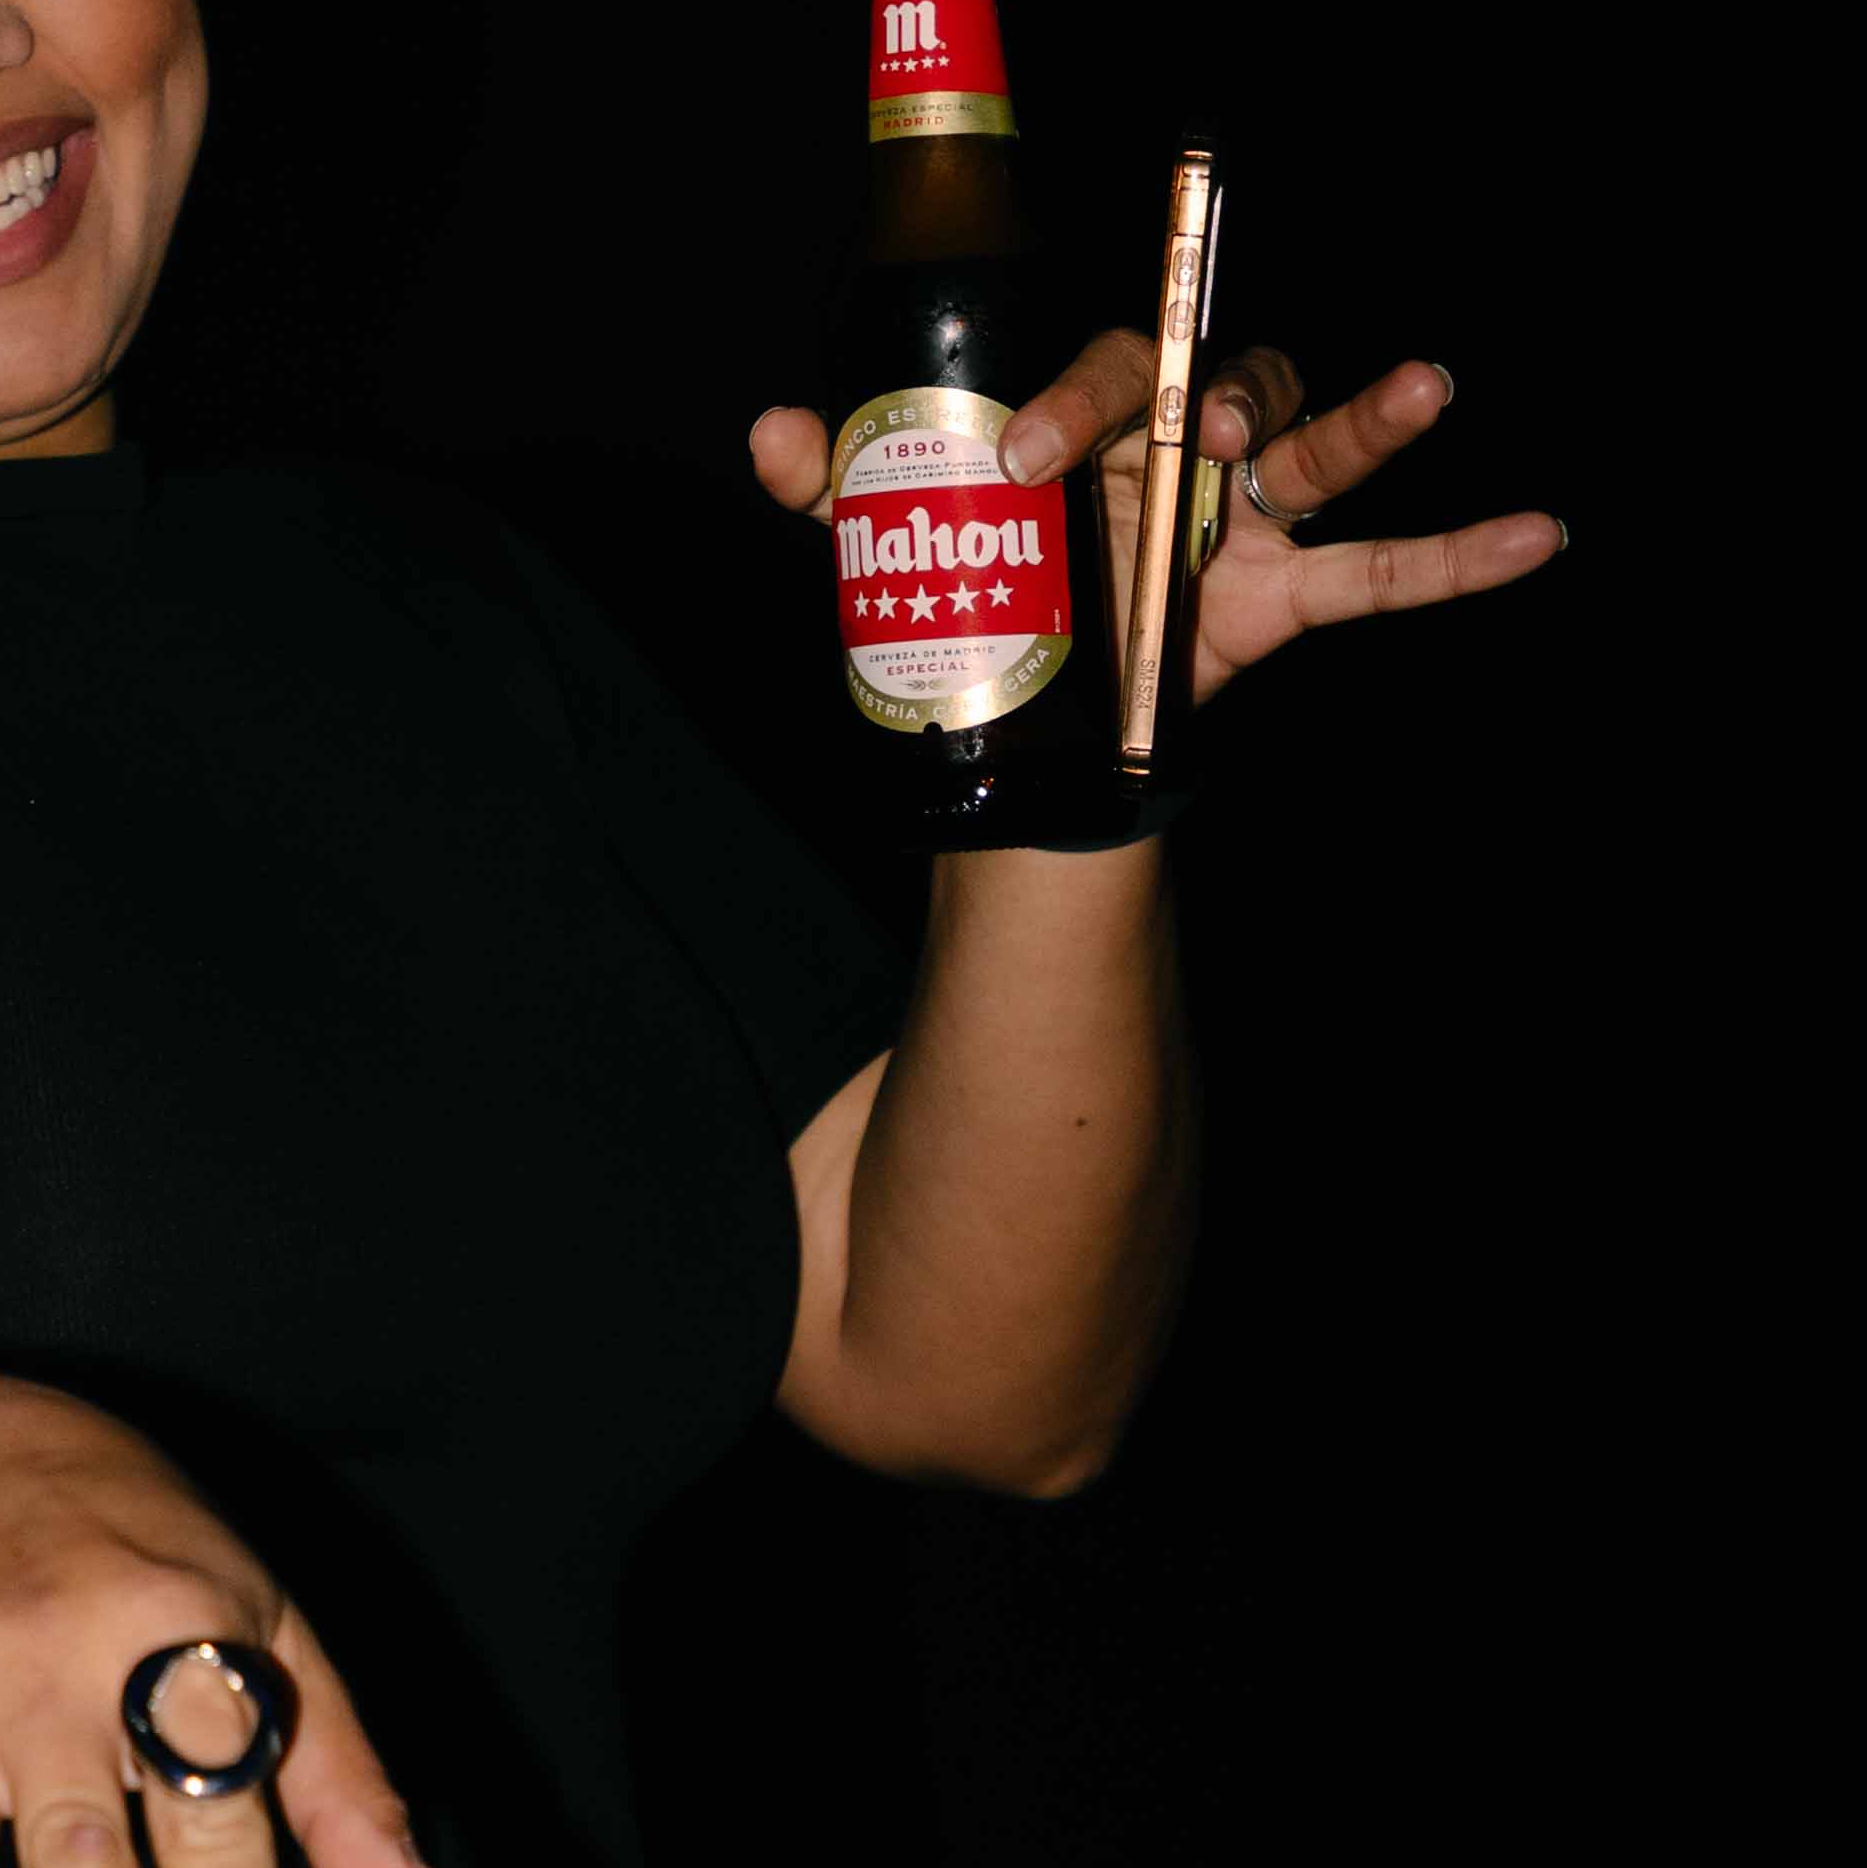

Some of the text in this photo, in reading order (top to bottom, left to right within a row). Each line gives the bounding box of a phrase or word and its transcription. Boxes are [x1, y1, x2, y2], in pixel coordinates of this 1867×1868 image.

[884, 117, 944, 130] MADRID
[836, 419, 877, 473] CINCO
[884, 440, 946, 460] 1890
[836, 506, 1045, 581] Mahou
[869, 651, 917, 663] CERVEZA
[923, 650, 937, 658] DE
[886, 662, 970, 676] ESPECIAL
